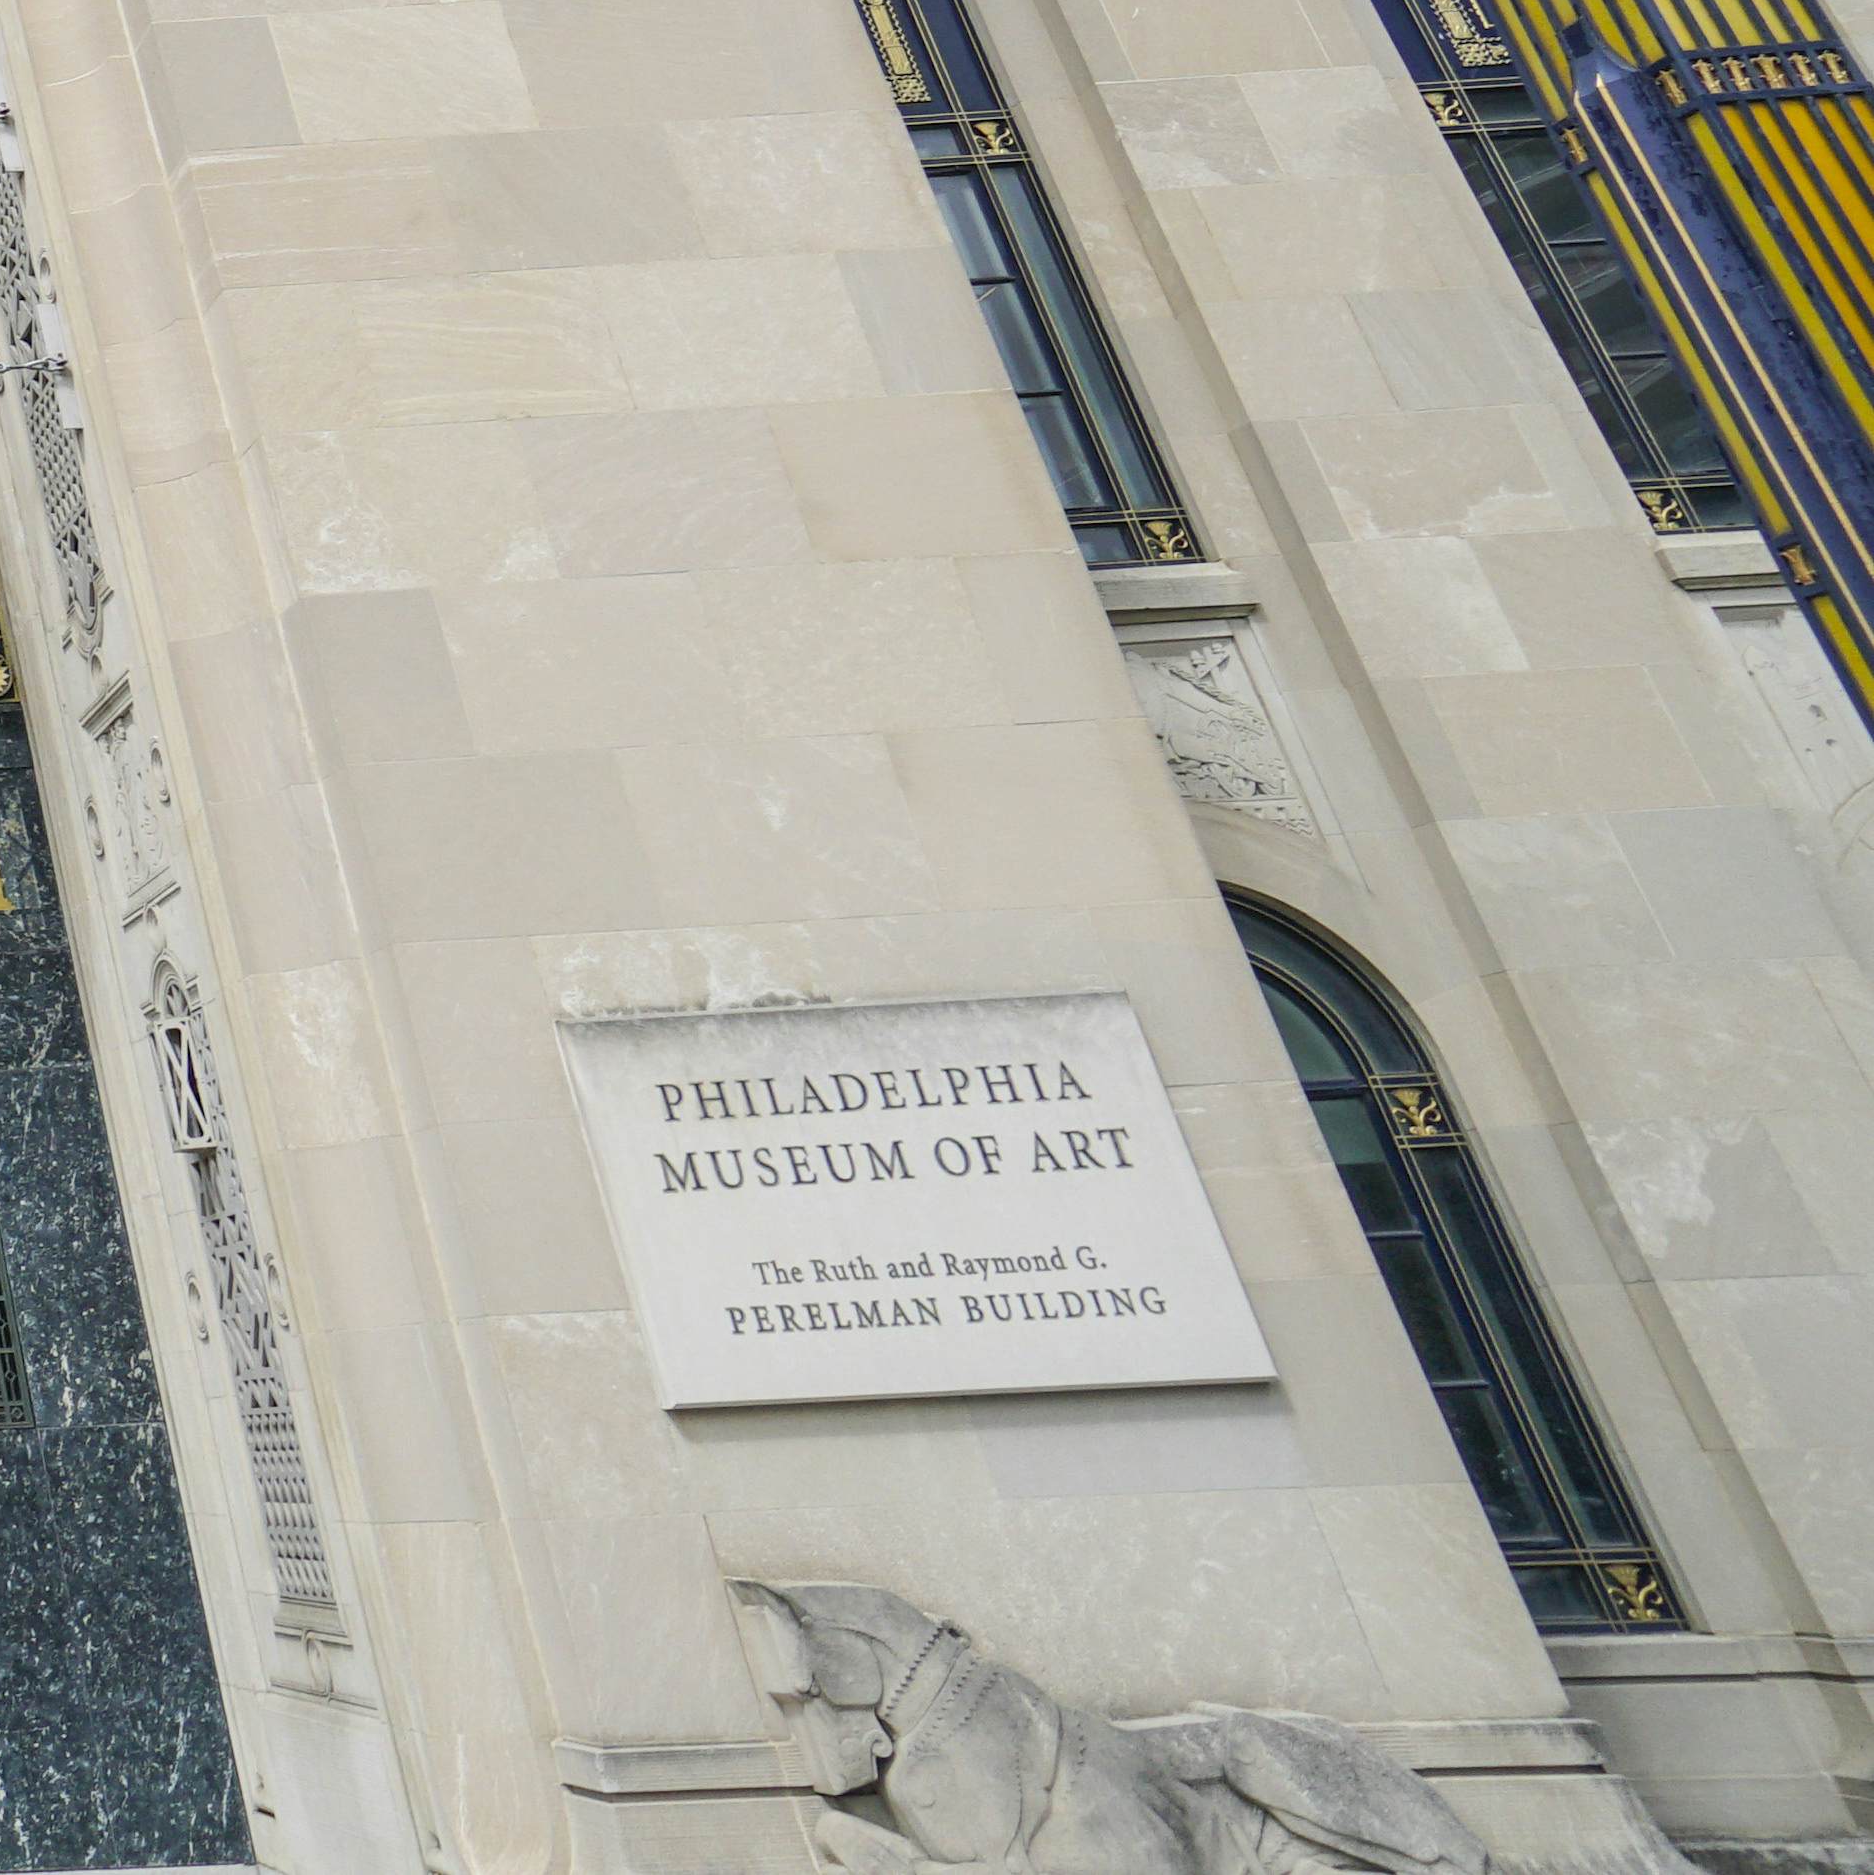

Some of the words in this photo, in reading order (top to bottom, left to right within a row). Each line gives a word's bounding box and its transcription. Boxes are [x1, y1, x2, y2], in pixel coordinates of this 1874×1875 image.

[655, 1060, 1092, 1123] PHILADELPHIA
[654, 1139, 915, 1194] MUSEUM
[934, 1134, 1004, 1178] OF
[1031, 1126, 1135, 1175] ART
[752, 1258, 805, 1288] The
[812, 1254, 876, 1283] Ruth
[886, 1251, 935, 1280] and
[940, 1246, 1067, 1282] Raymond
[1075, 1245, 1108, 1271] G.
[725, 1296, 943, 1336] PERELMAN
[961, 1285, 1168, 1325] BUILDING
